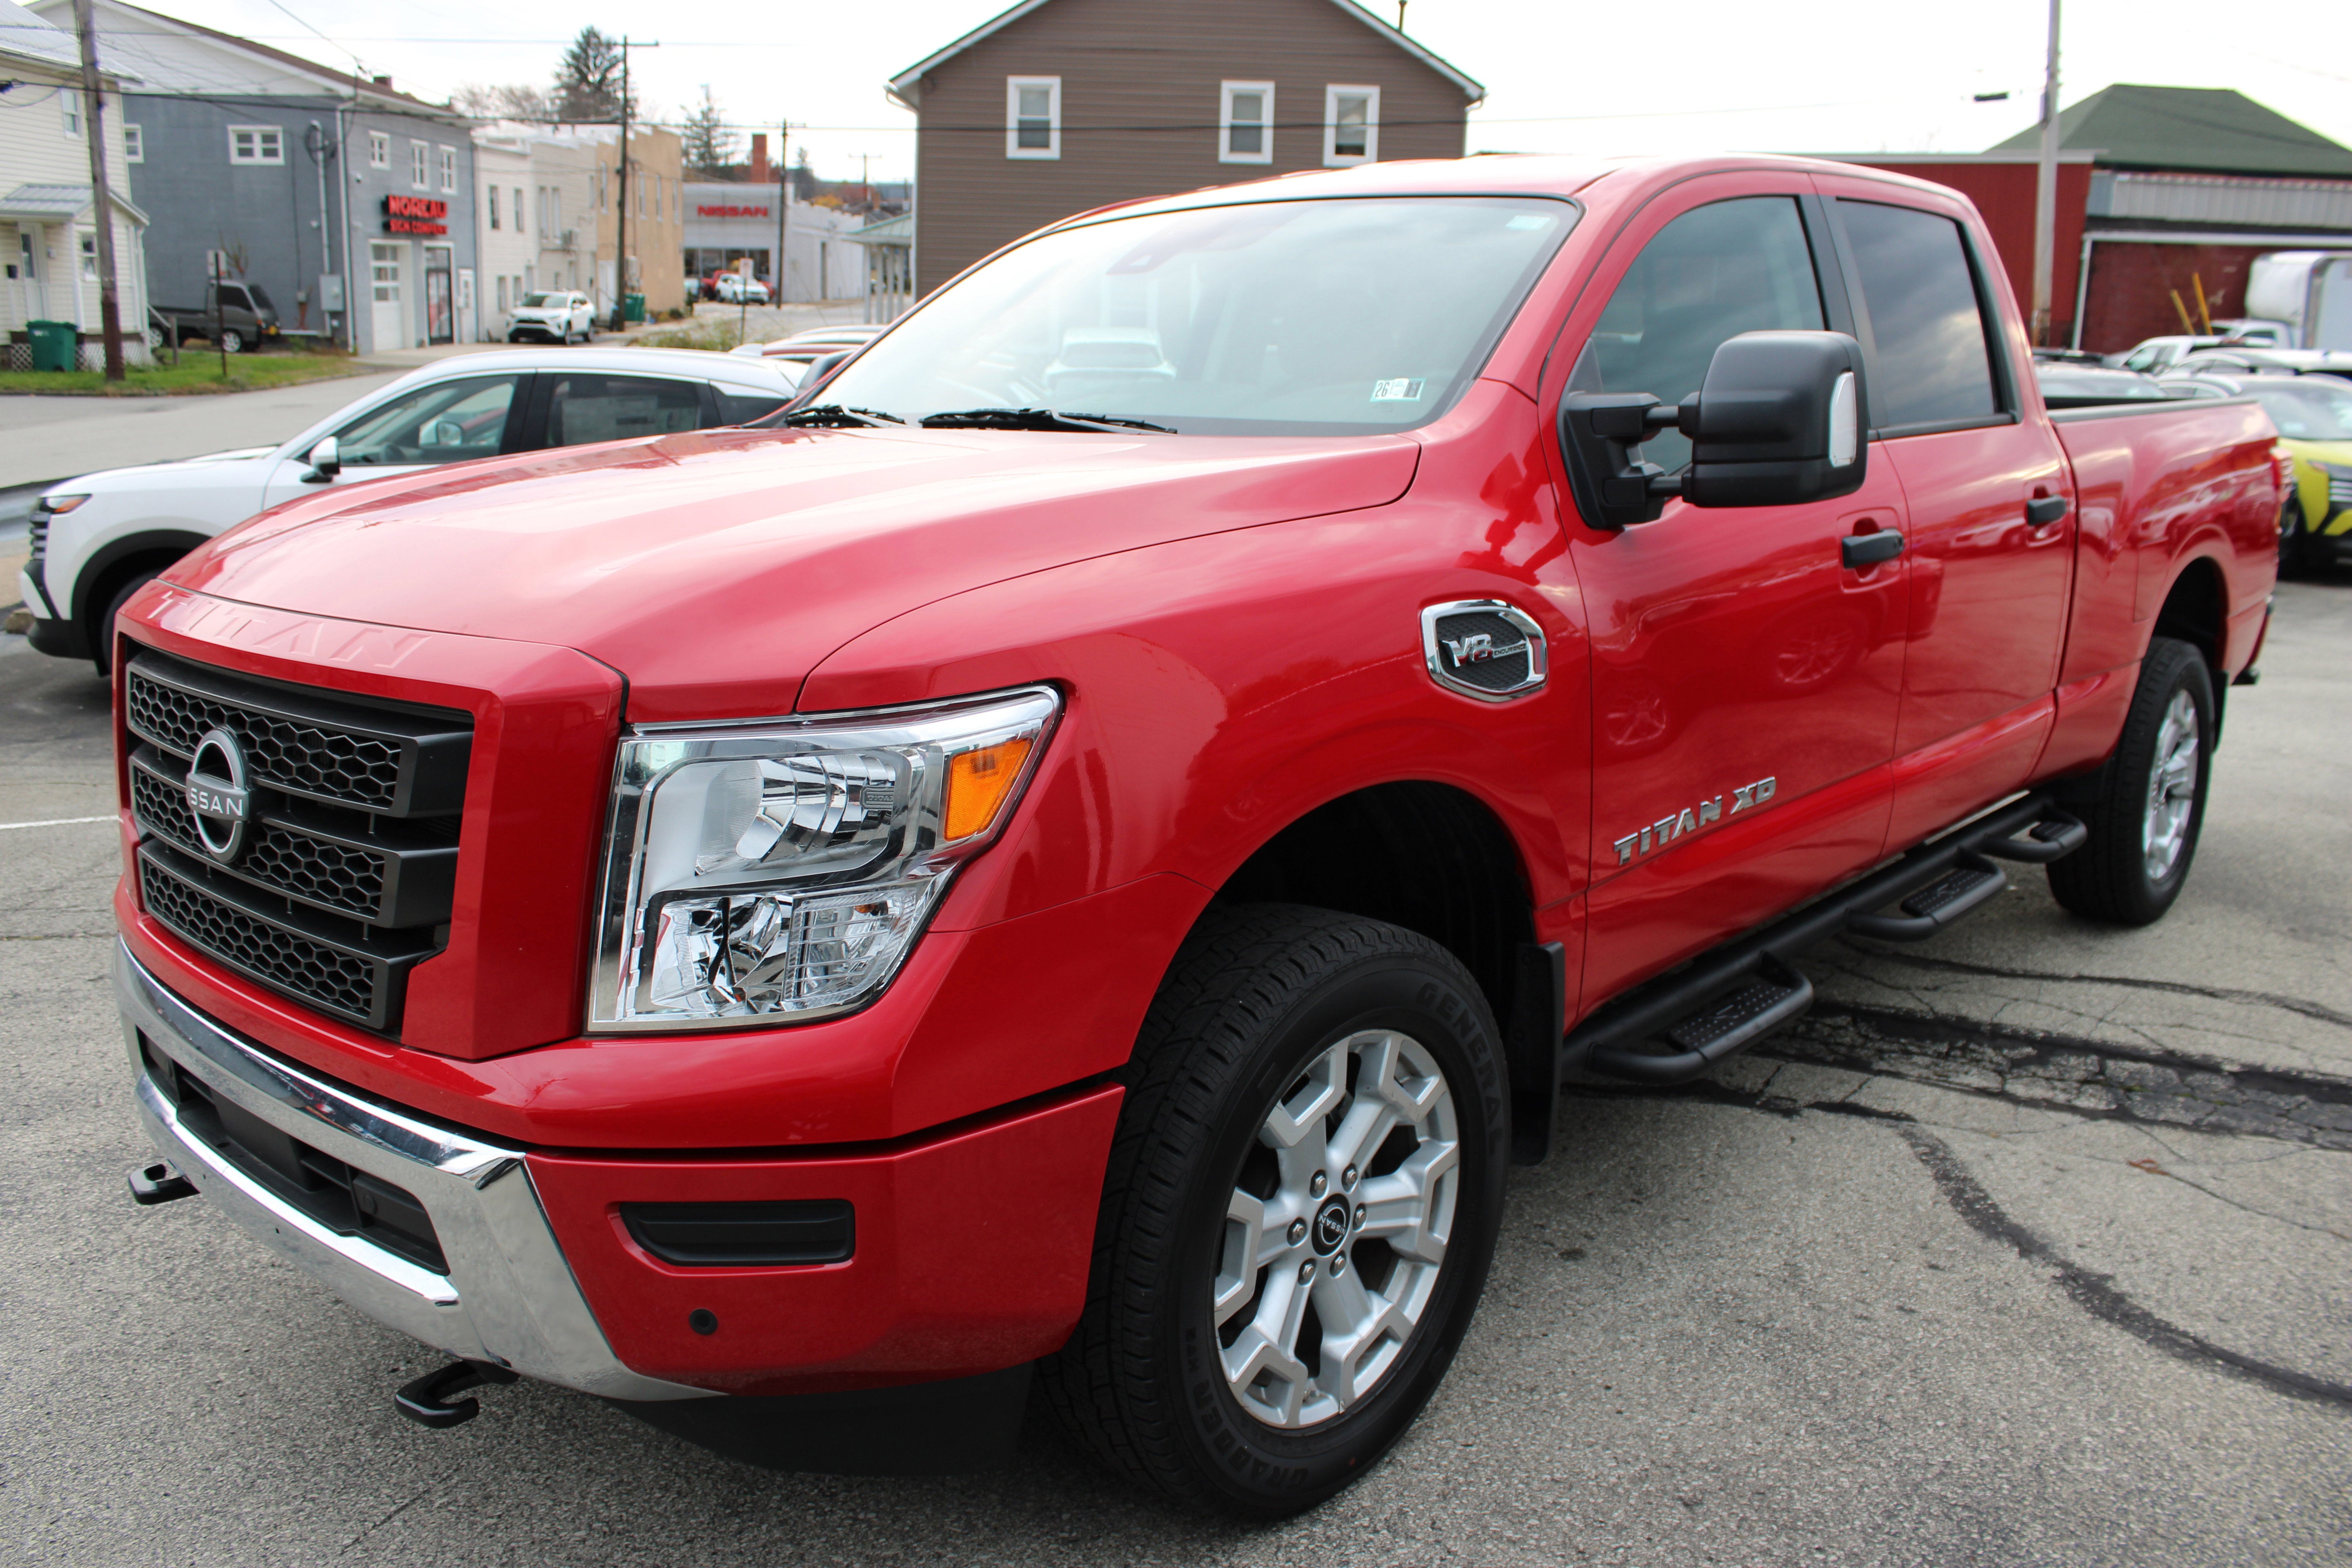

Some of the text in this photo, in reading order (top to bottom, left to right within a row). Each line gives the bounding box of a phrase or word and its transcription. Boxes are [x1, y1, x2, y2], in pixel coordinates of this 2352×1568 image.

[388, 194, 448, 218] MOREAU
[697, 205, 768, 217] NISSAN
[390, 219, 410, 232] SIGN
[1375, 382, 1390, 398] 26
[147, 590, 432, 668] TITAN
[1442, 634, 1527, 667] V8 ENDURANCE
[190, 787, 243, 816] SSAN
[1614, 776, 1776, 866] TITAN XD
[1416, 981, 1504, 1156] GENERAL
[1319, 1215, 1346, 1235] NISSAN
[1193, 1380, 1309, 1492] GRABBER
